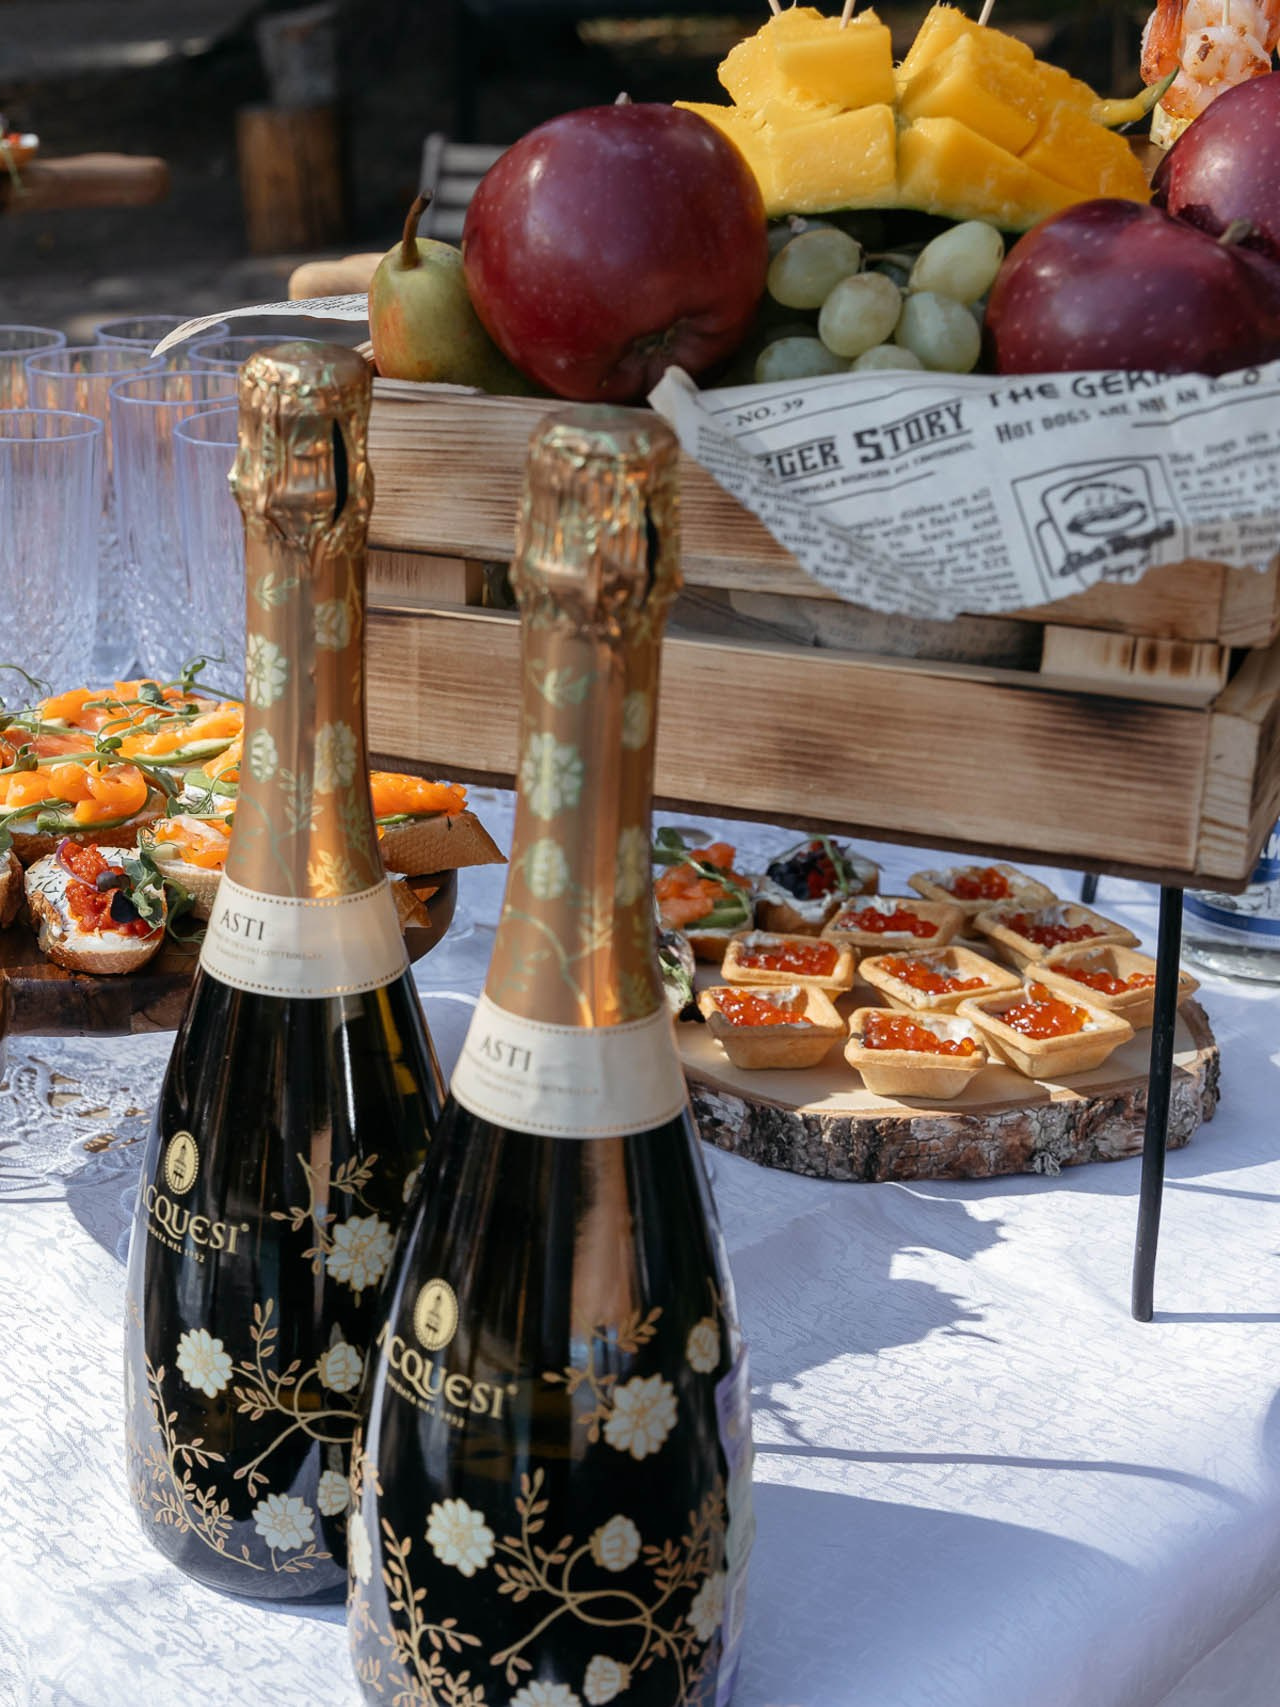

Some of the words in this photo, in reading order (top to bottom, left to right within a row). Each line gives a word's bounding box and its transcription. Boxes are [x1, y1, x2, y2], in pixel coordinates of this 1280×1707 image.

[854, 402, 965, 464] STORY
[995, 421, 1035, 443] HOT
[1042, 409, 1091, 430] DOGS
[219, 909, 265, 941] ASTI
[479, 1034, 532, 1073] ASTI
